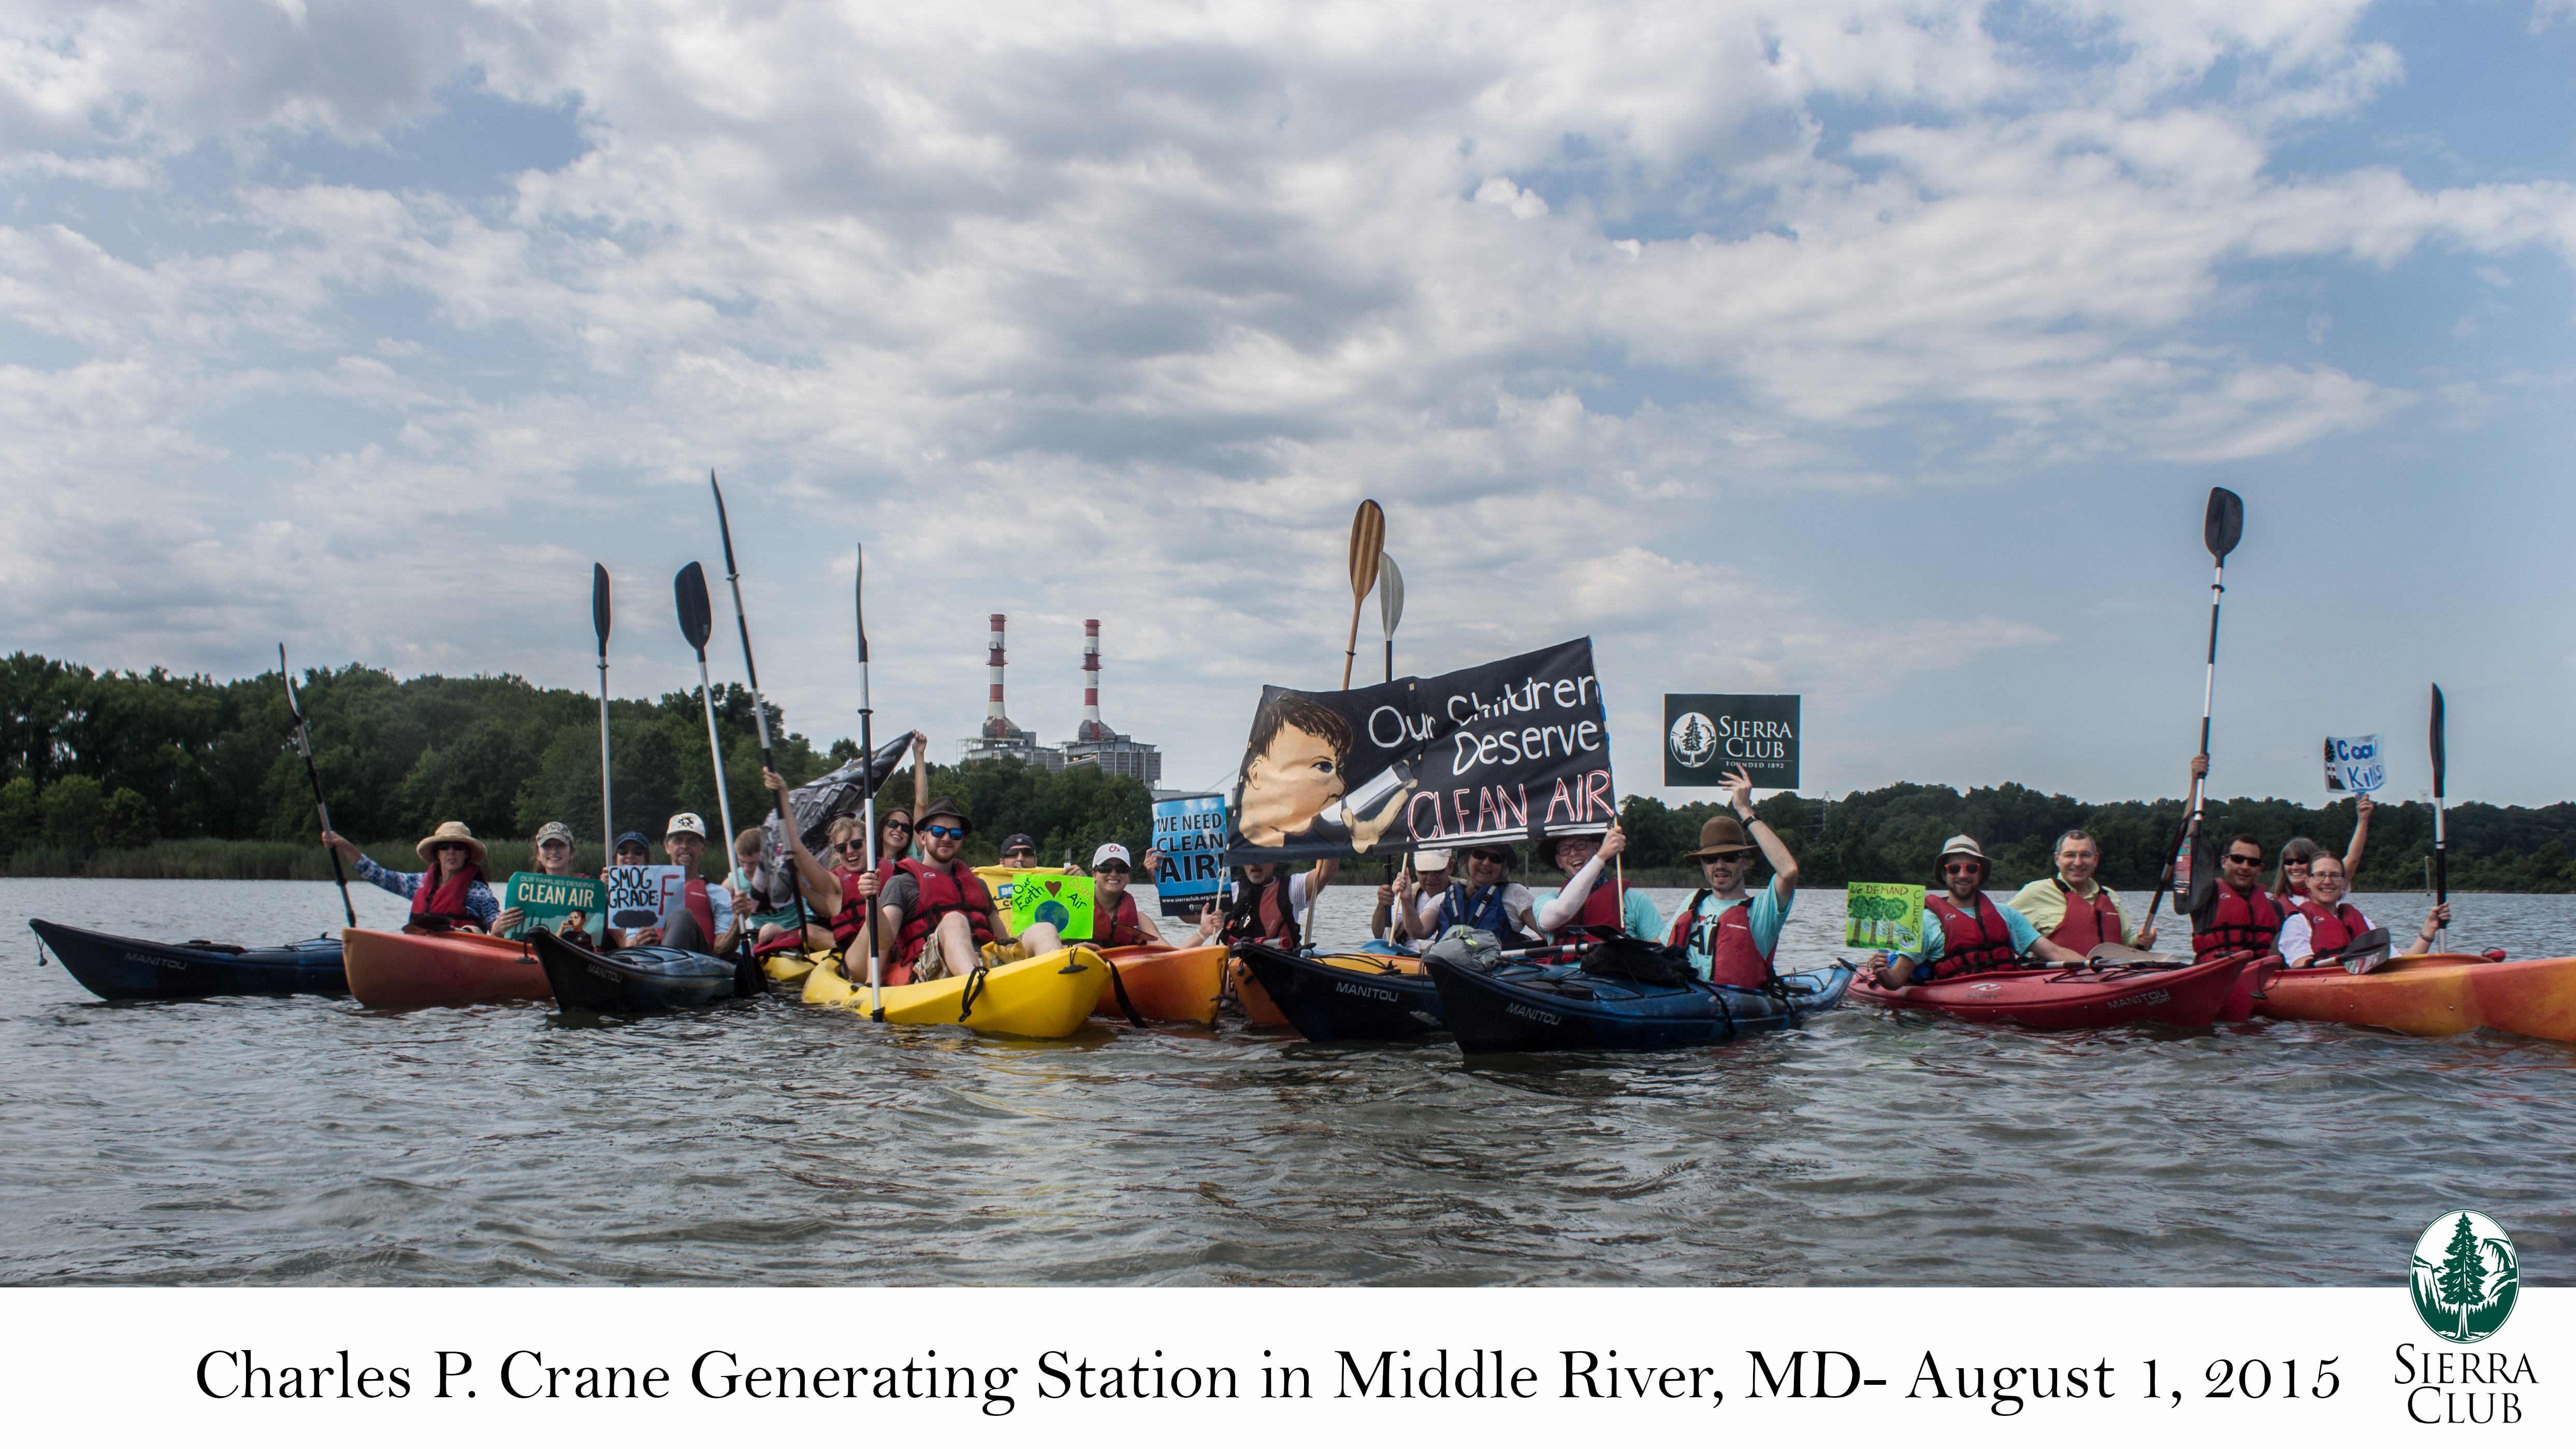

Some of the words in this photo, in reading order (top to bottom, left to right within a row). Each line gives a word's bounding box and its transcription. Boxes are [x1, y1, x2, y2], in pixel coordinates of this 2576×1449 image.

[1368, 705, 1436, 747] Our
[1448, 676, 1599, 726] Children
[1719, 716, 1793, 738] SIERRA
[1453, 720, 1599, 775] Deserve
[1726, 737, 1784, 758] CLUB
[2336, 738, 2377, 761] Coal
[2346, 764, 2382, 788] Kills
[1407, 784, 1527, 842] CLEAN
[1544, 770, 1614, 823] AIR
[1157, 817, 1178, 833] WE
[1182, 813, 1222, 831] NEED
[1156, 833, 1224, 853] CLEAN
[610, 867, 652, 889] SMOG
[1160, 852, 1227, 883] AIR!
[536, 877, 565, 886] FAMILIES
[566, 880, 596, 889] DESERVE
[1013, 877, 1030, 894] Our
[1067, 876, 1094, 901] Clean
[1850, 885, 1863, 894] We
[1865, 885, 1908, 896] DEMAND
[518, 883, 564, 905] CLEAN
[568, 887, 595, 908] AIR
[608, 888, 659, 908] GRADE:
[658, 875, 680, 916] F
[1015, 885, 1046, 911] Earth
[1066, 893, 1087, 909] Air
[1162, 893, 1230, 903] www.sierraclub.org/astma
[125, 952, 187, 970] MANITOU
[587, 964, 623, 983] MANITOU
[1336, 982, 1398, 1002] MANITOU
[2107, 989, 2169, 1009] MANITOU
[1506, 1003, 1561, 1025] MANITOU
